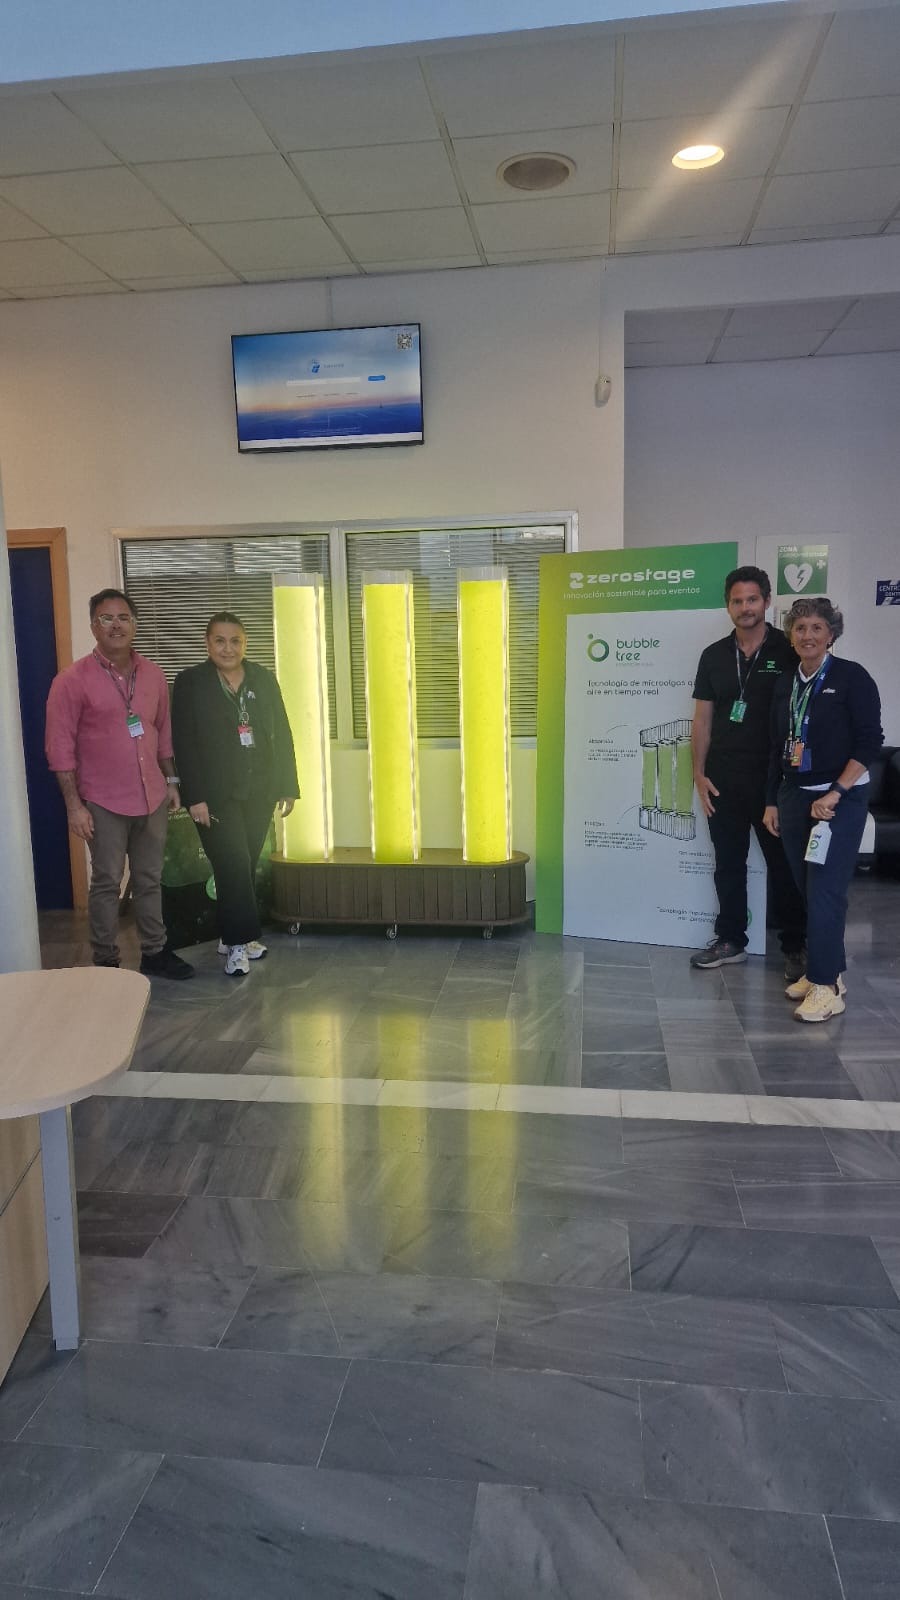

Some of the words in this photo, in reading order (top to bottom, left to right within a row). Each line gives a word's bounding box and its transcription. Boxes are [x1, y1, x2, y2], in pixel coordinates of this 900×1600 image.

[587, 568, 696, 584] zerostage
[606, 588, 646, 597] sostenible
[647, 588, 667, 597] para
[668, 586, 700, 595] eventos
[616, 637, 661, 649] bubble
[615, 651, 641, 661] tree
[630, 679, 639, 687] de
[641, 679, 686, 688] microalgas
[586, 688, 602, 696] aire
[614, 688, 642, 696] tiempo
